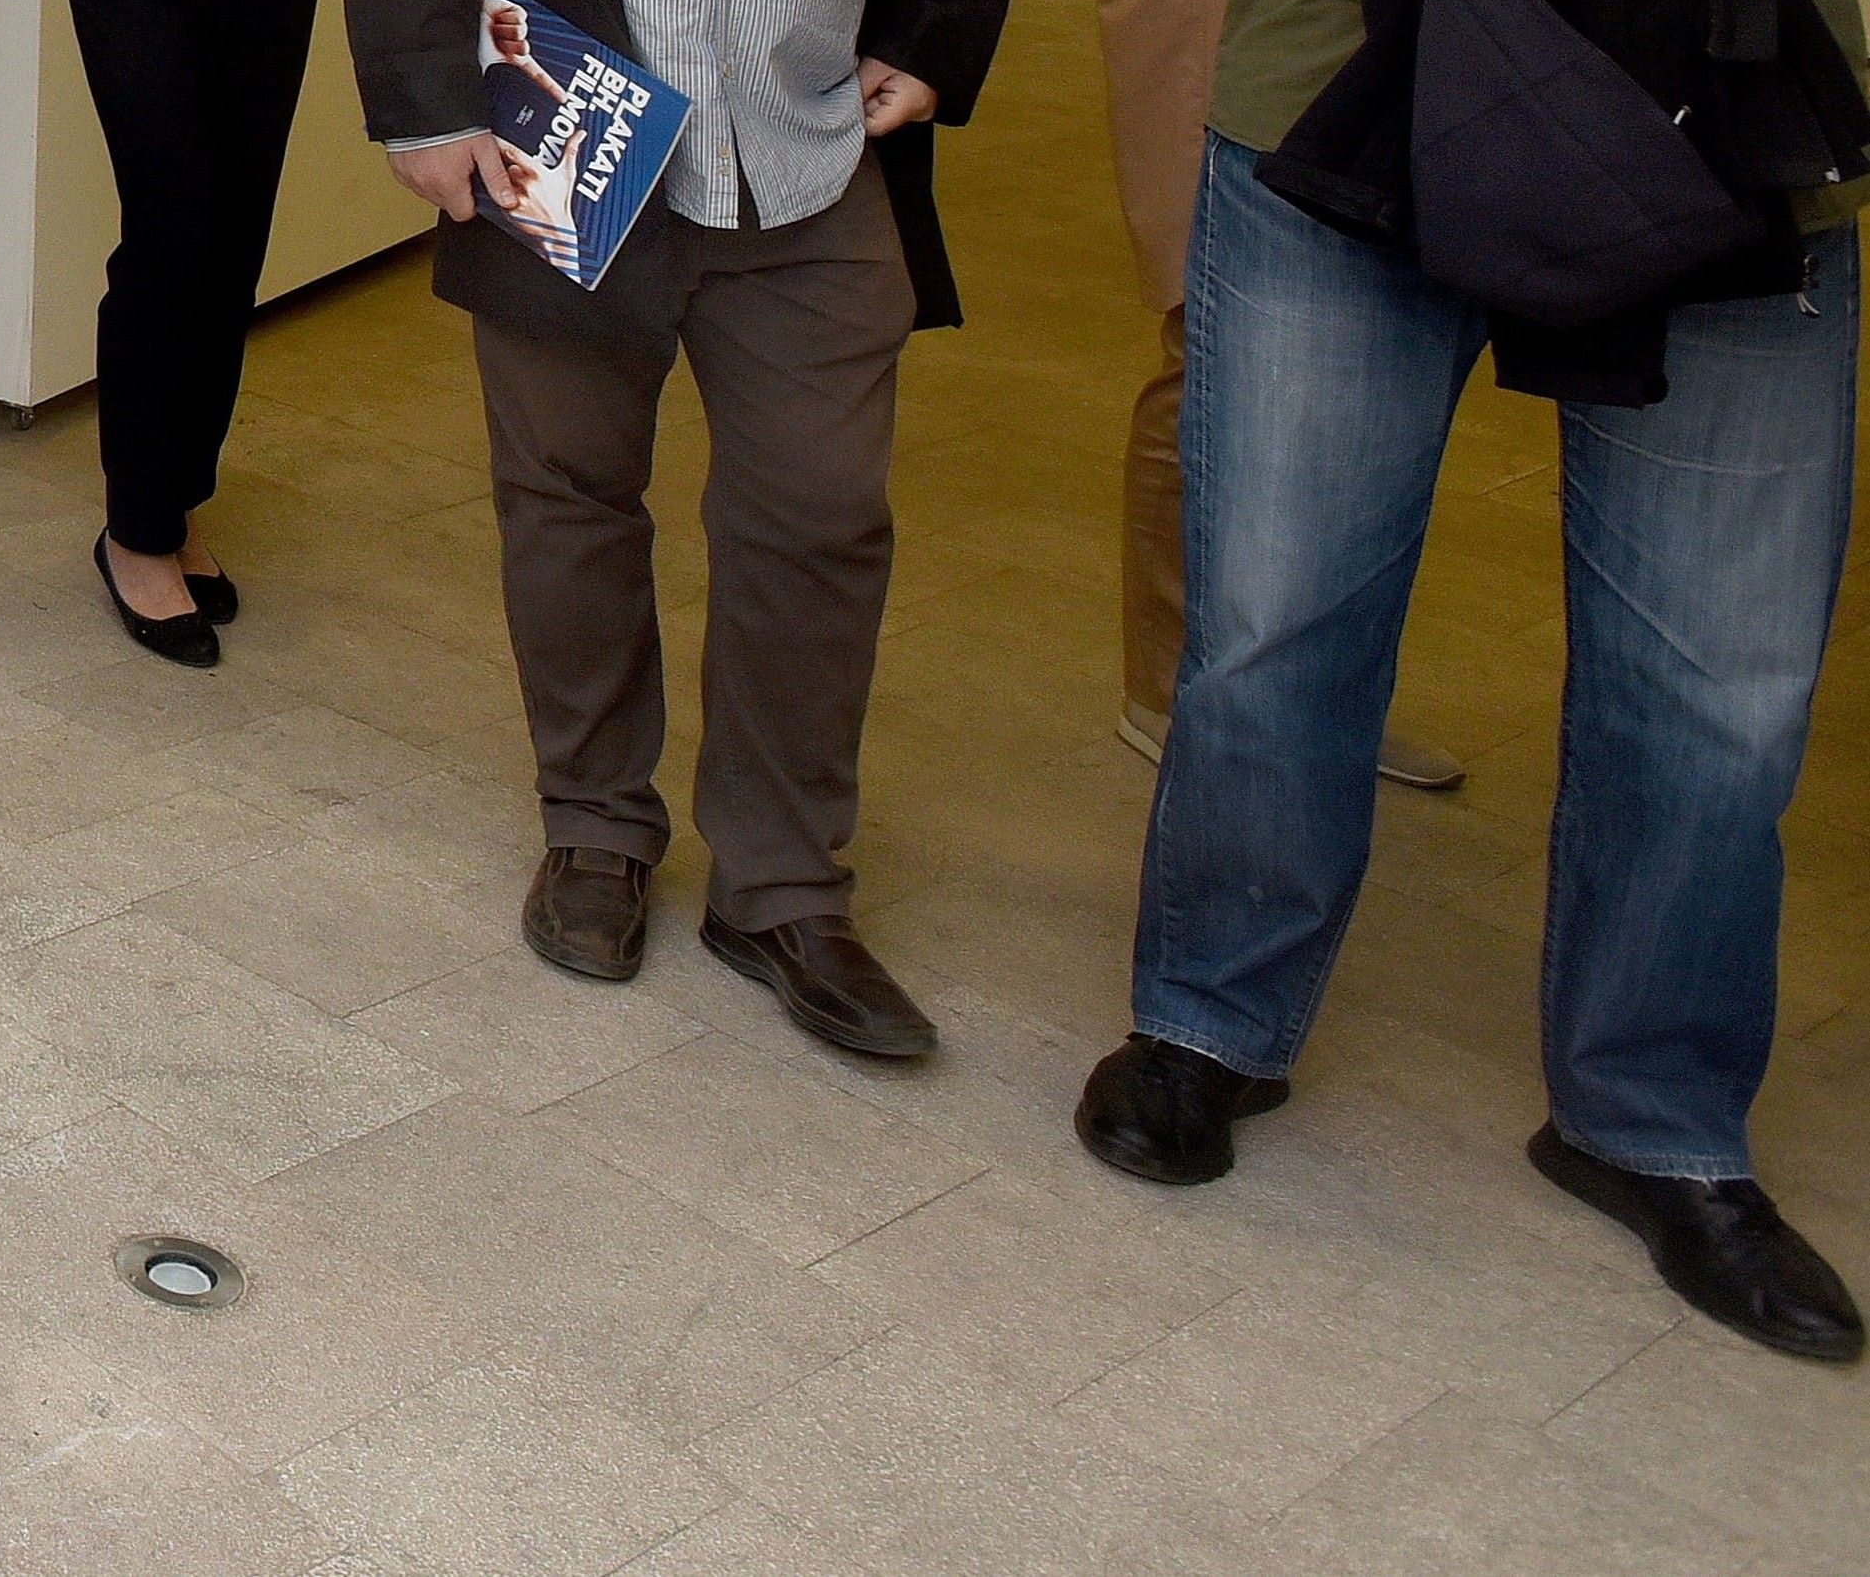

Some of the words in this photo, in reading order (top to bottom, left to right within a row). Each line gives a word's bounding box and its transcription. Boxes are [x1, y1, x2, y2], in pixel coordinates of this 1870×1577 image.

[533, 53, 606, 167] FILMOVA
[576, 81, 651, 202] PLAKATI
[588, 67, 628, 114] BH.
